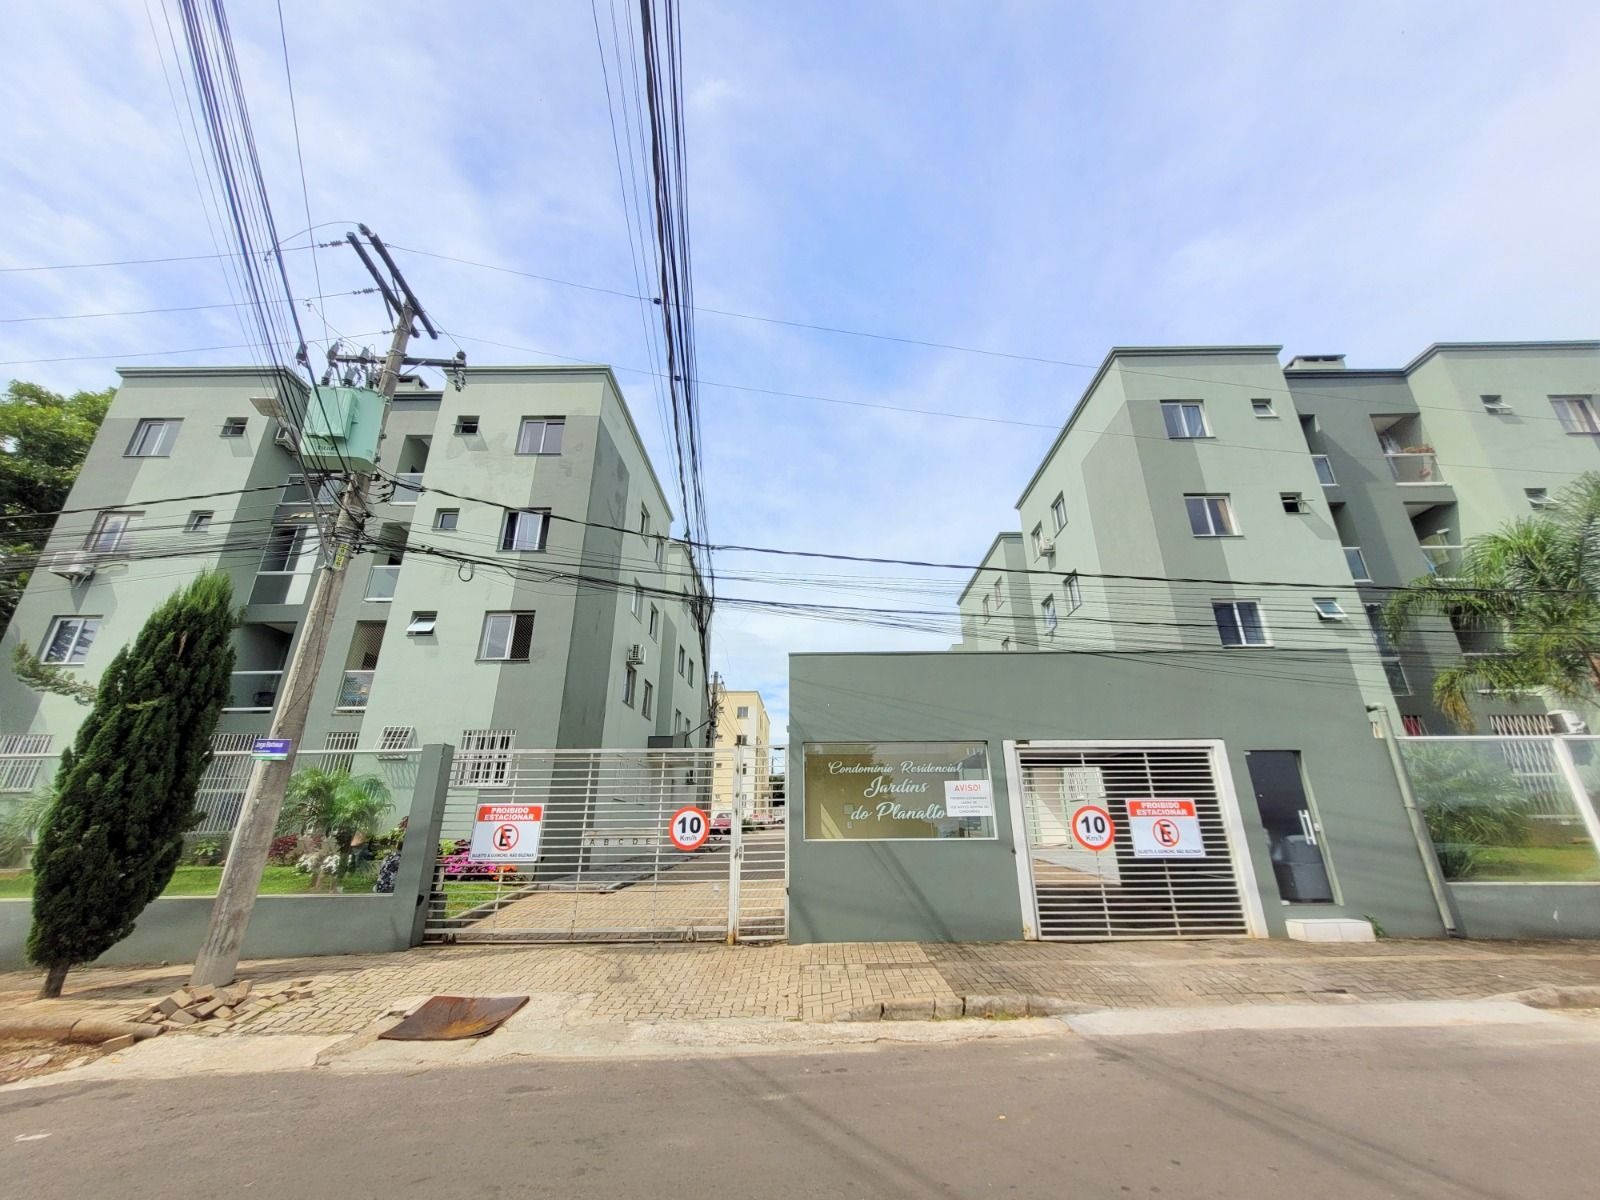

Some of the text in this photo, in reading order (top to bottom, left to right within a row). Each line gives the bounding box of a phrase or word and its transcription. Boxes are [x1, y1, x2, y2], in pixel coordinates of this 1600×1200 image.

[899, 760, 964, 774] Residencial
[864, 776, 930, 798] Jardins
[954, 784, 981, 792] AVISO!
[851, 802, 946, 822] do Planalto
[1136, 808, 1188, 816] ESTACIONAR
[678, 817, 702, 834] 10
[1081, 816, 1105, 834] 10
[680, 834, 697, 842] Km/h
